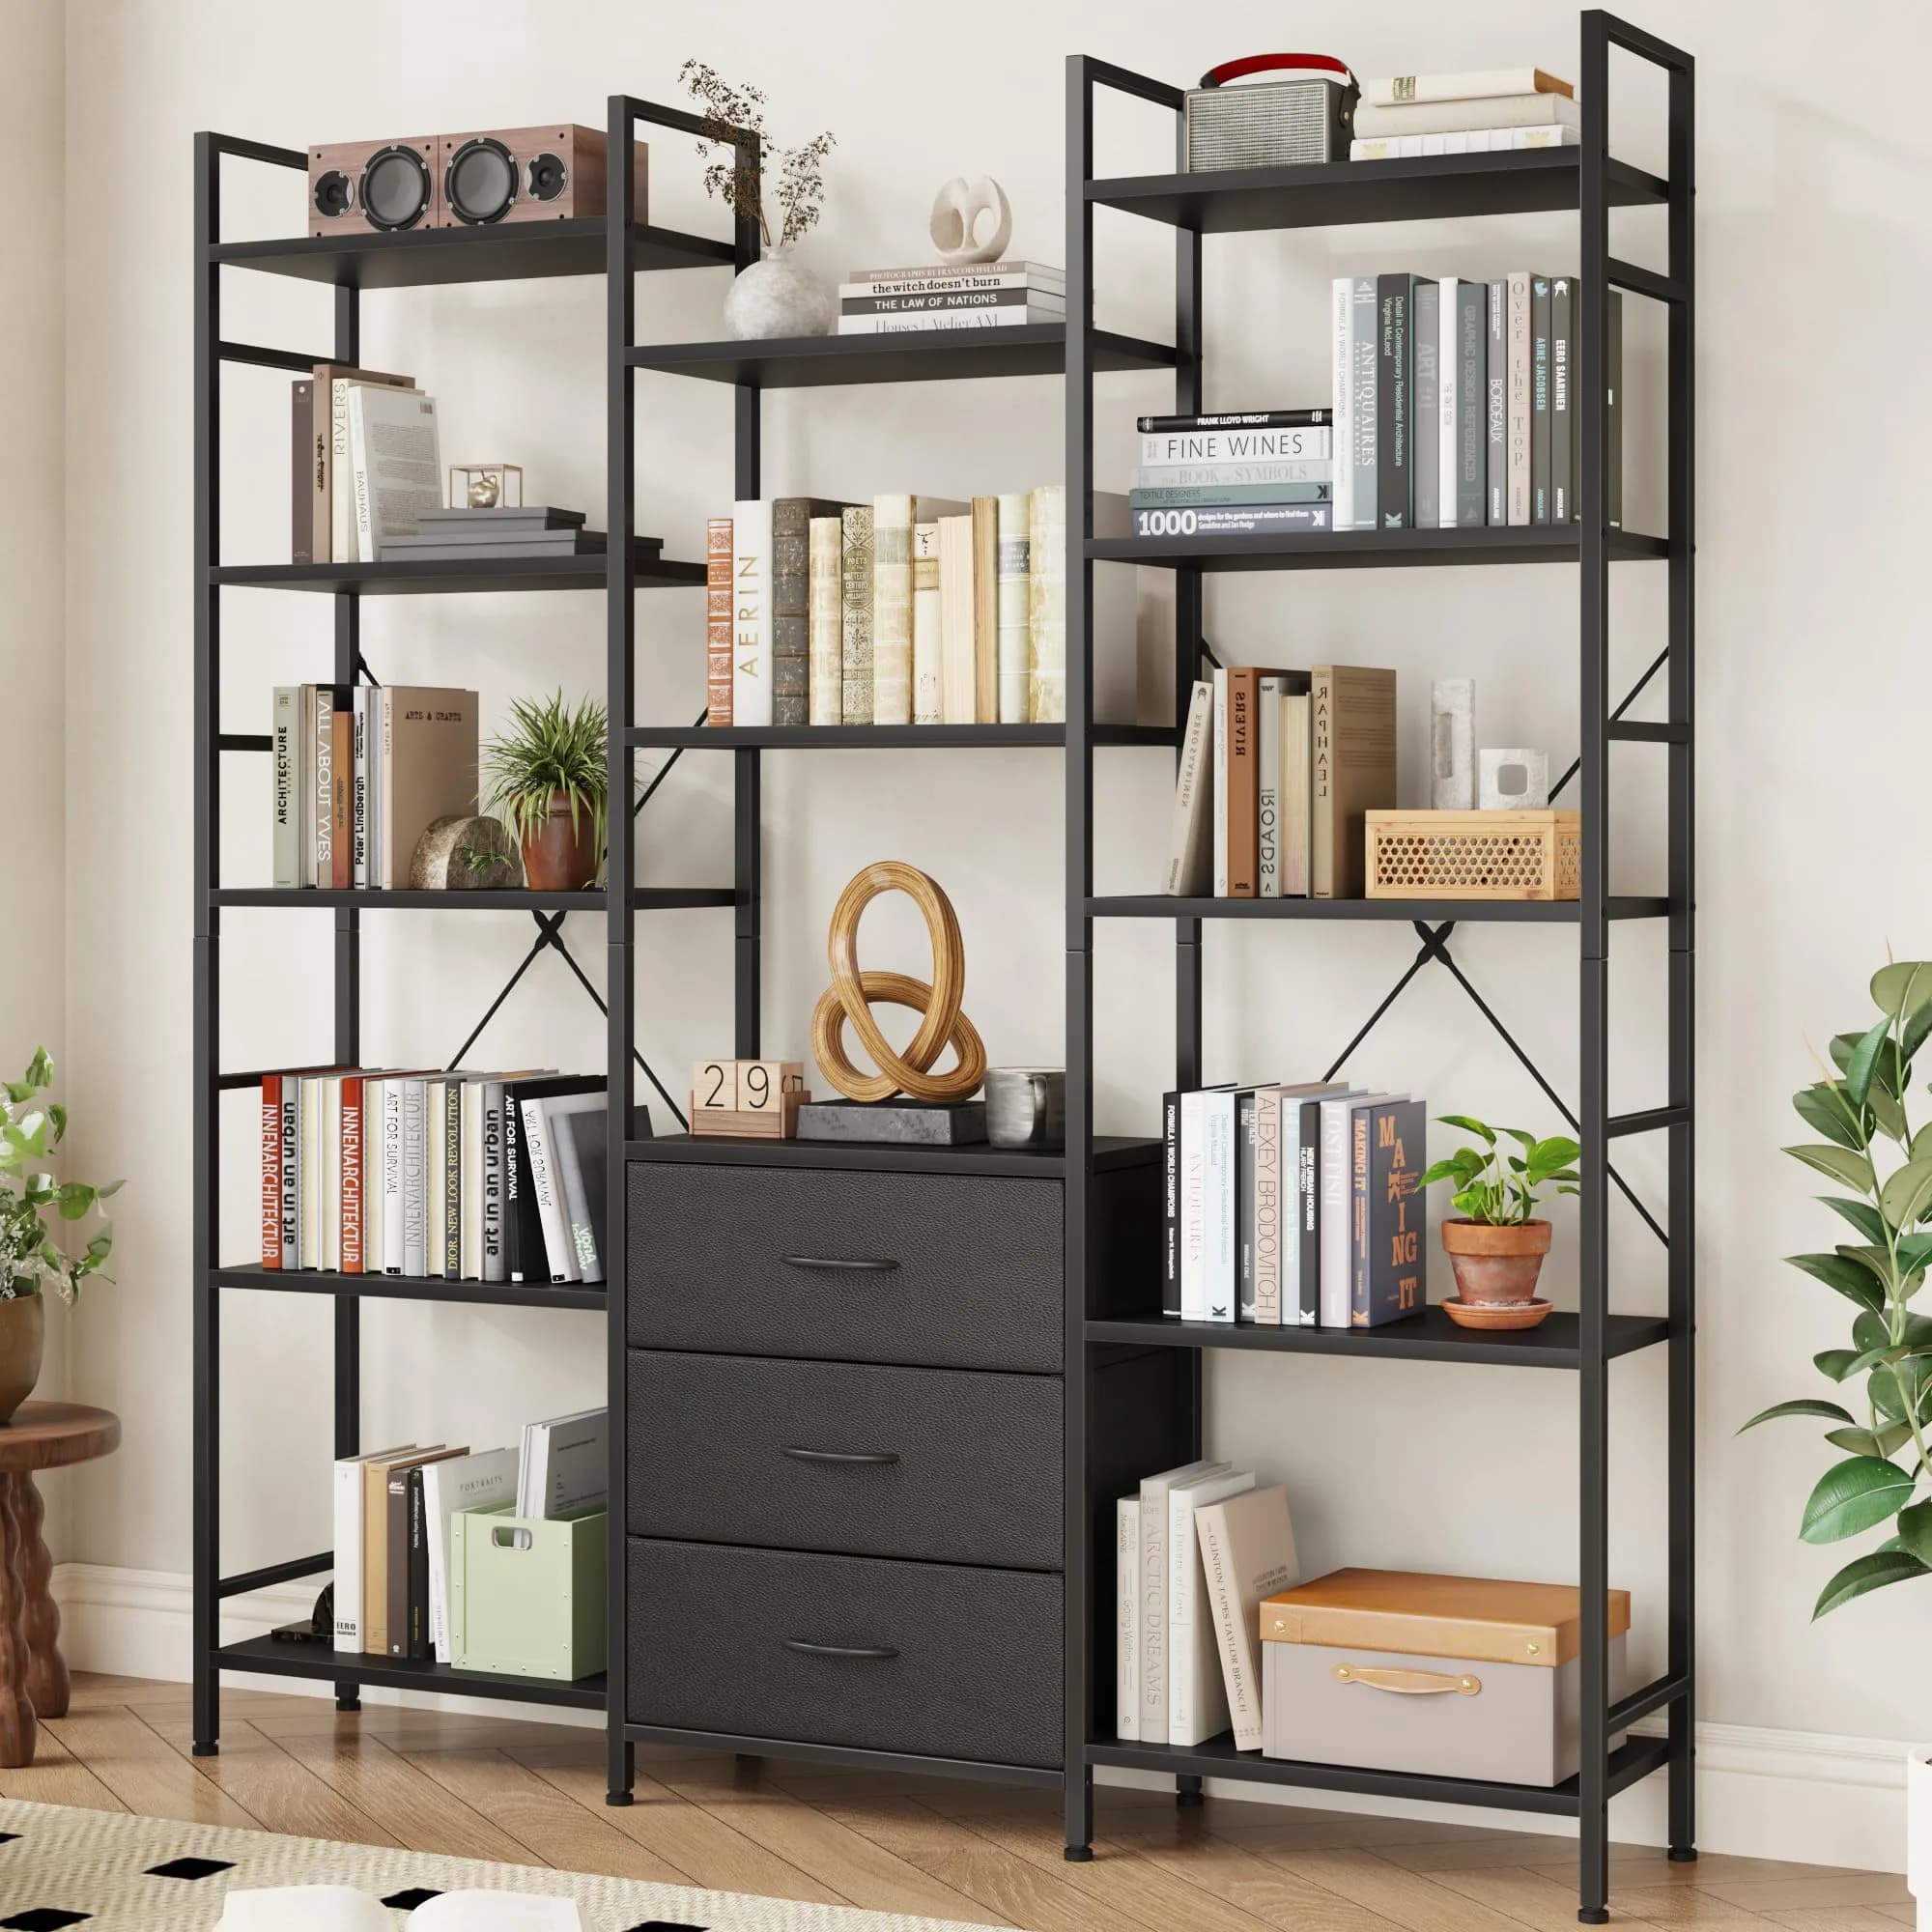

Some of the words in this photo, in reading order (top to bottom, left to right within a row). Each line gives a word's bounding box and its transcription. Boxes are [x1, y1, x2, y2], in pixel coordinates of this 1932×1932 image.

[874, 299, 897, 310] THE
[901, 298, 924, 309] LAW
[928, 296, 943, 307] OF
[947, 294, 998, 306] NATIONS
[926, 277, 970, 291] doesn't
[972, 276, 1001, 288] burn
[1382, 298, 1392, 325] Virginia
[1395, 296, 1404, 318] Detail
[1383, 327, 1392, 356] McLeod
[1393, 327, 1404, 380] Contemporary
[1417, 342, 1435, 381] ART
[1536, 337, 1546, 362] ARNE
[1555, 339, 1565, 362] EERO
[1359, 341, 1376, 467] ANTIQUAIRES
[1394, 381, 1404, 421] Residential
[1536, 364, 1546, 411] JACOBSEN
[1555, 365, 1565, 411] SAARINEN
[334, 384, 346, 455] RIVERS
[1197, 416, 1219, 426] FRANK
[1220, 415, 1241, 425] LLOYD
[1242, 414, 1269, 425] WRIGHT
[1491, 379, 1503, 443] BORDEAUX
[1167, 437, 1217, 459] FINE
[1228, 434, 1303, 457] WINES
[1394, 422, 1404, 467] Architecture
[355, 471, 368, 533] BAUHAUS
[1138, 510, 1198, 536] 1000
[738, 556, 758, 678] AERIN
[318, 699, 331, 734] ALL
[277, 726, 287, 824] ARCHITECTURE
[318, 740, 331, 808] ABOUT
[355, 777, 365, 833] Lindbergh
[318, 814, 331, 862] YVES
[355, 836, 364, 866] Peter
[386, 1092, 398, 1113] ART
[505, 1095, 516, 1118] ART
[282, 1102, 296, 1158] urban
[386, 1117, 398, 1140] FOR
[447, 1089, 458, 1166] REVOLUTION
[483, 1109, 499, 1167] urban
[505, 1122, 517, 1145] FOR
[1258, 1096, 1276, 1175] ALEXEY
[1354, 1118, 1367, 1174] MAKING
[263, 1104, 278, 1258] INNENARCHITEKTUR
[283, 1165, 296, 1187] an
[342, 1106, 359, 1263] INNENARCHITEKTUR
[386, 1144, 398, 1195] SURVIVAL
[405, 1093, 421, 1248] INNENARCHITEKTUR
[447, 1170, 458, 1203] LOOK
[485, 1174, 499, 1197] an
[507, 1148, 518, 1201] SURVIVAL
[1354, 1176, 1367, 1191] IT
[282, 1193, 296, 1210] in
[447, 1207, 458, 1234] NEW
[484, 1203, 498, 1221] in
[283, 1218, 296, 1244] art
[485, 1228, 499, 1256] art
[1258, 1179, 1276, 1309] BRODOVITCH
[1146, 1522, 1162, 1606] ARCTIC
[1208, 1534, 1224, 1584] CLINTON
[1218, 1586, 1231, 1620] TAPES
[1146, 1613, 1162, 1708] DREAMS
[1224, 1622, 1238, 1663] TAYLOR
[1232, 1666, 1248, 1713] BRANCH
